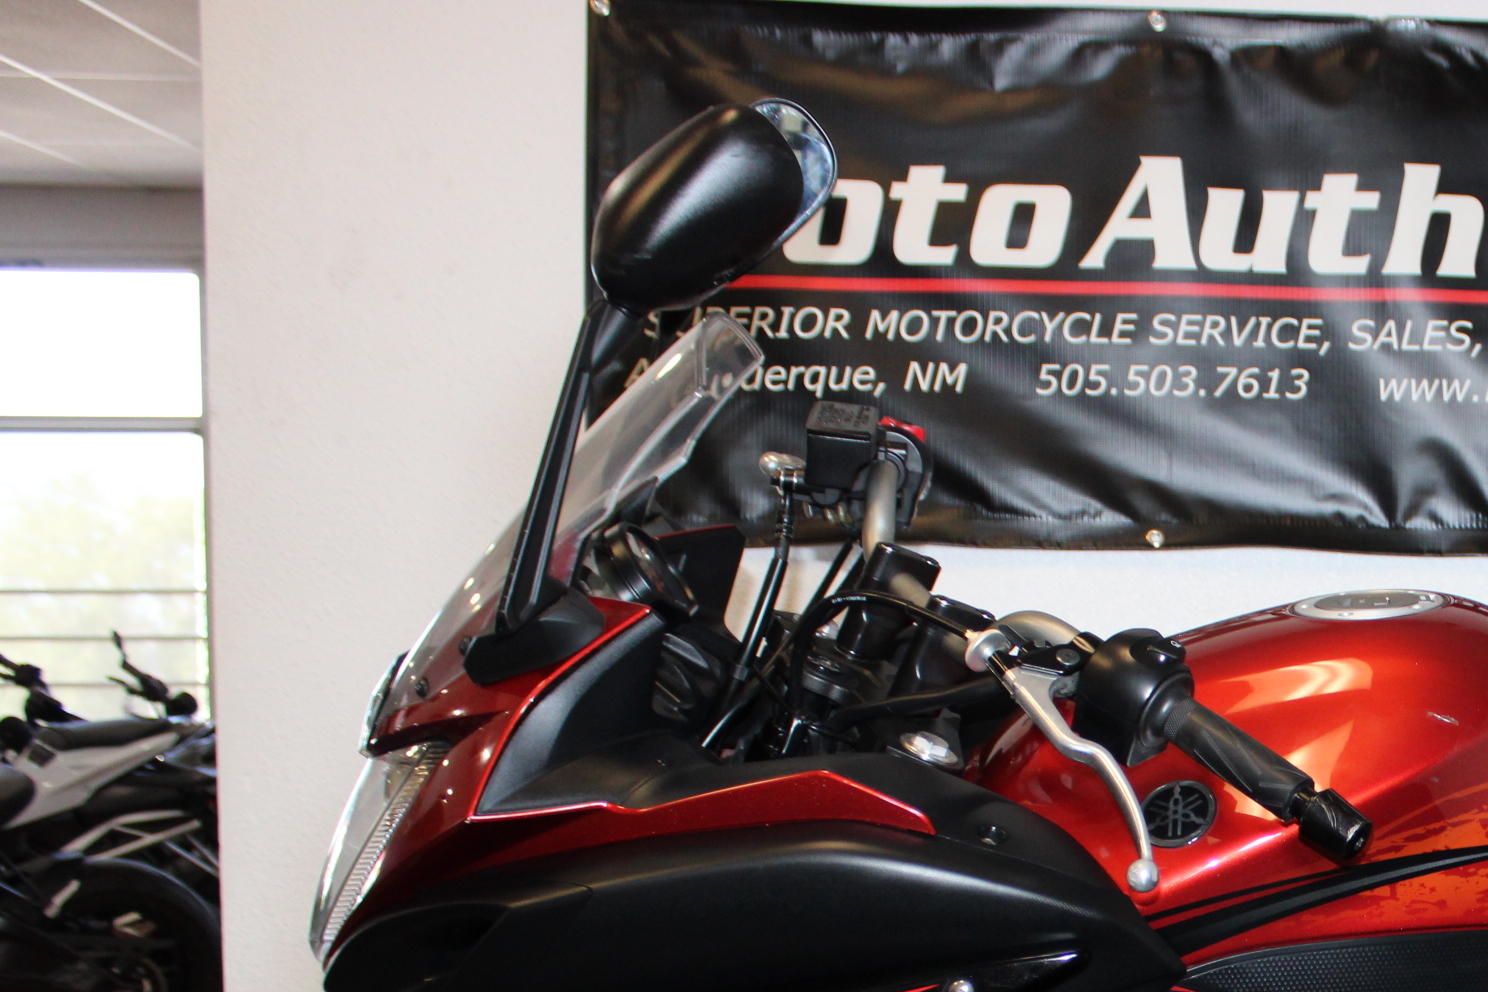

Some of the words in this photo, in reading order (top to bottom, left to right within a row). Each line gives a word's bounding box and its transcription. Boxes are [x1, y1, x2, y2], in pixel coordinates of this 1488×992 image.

[781, 164, 1072, 267] oto
[864, 310, 1139, 345] MOTORCYCLE
[1148, 313, 1331, 355] SERVICE,
[1348, 318, 1482, 359] SALES,
[903, 361, 968, 394] NM
[1036, 363, 1310, 400] 505.503.7613
